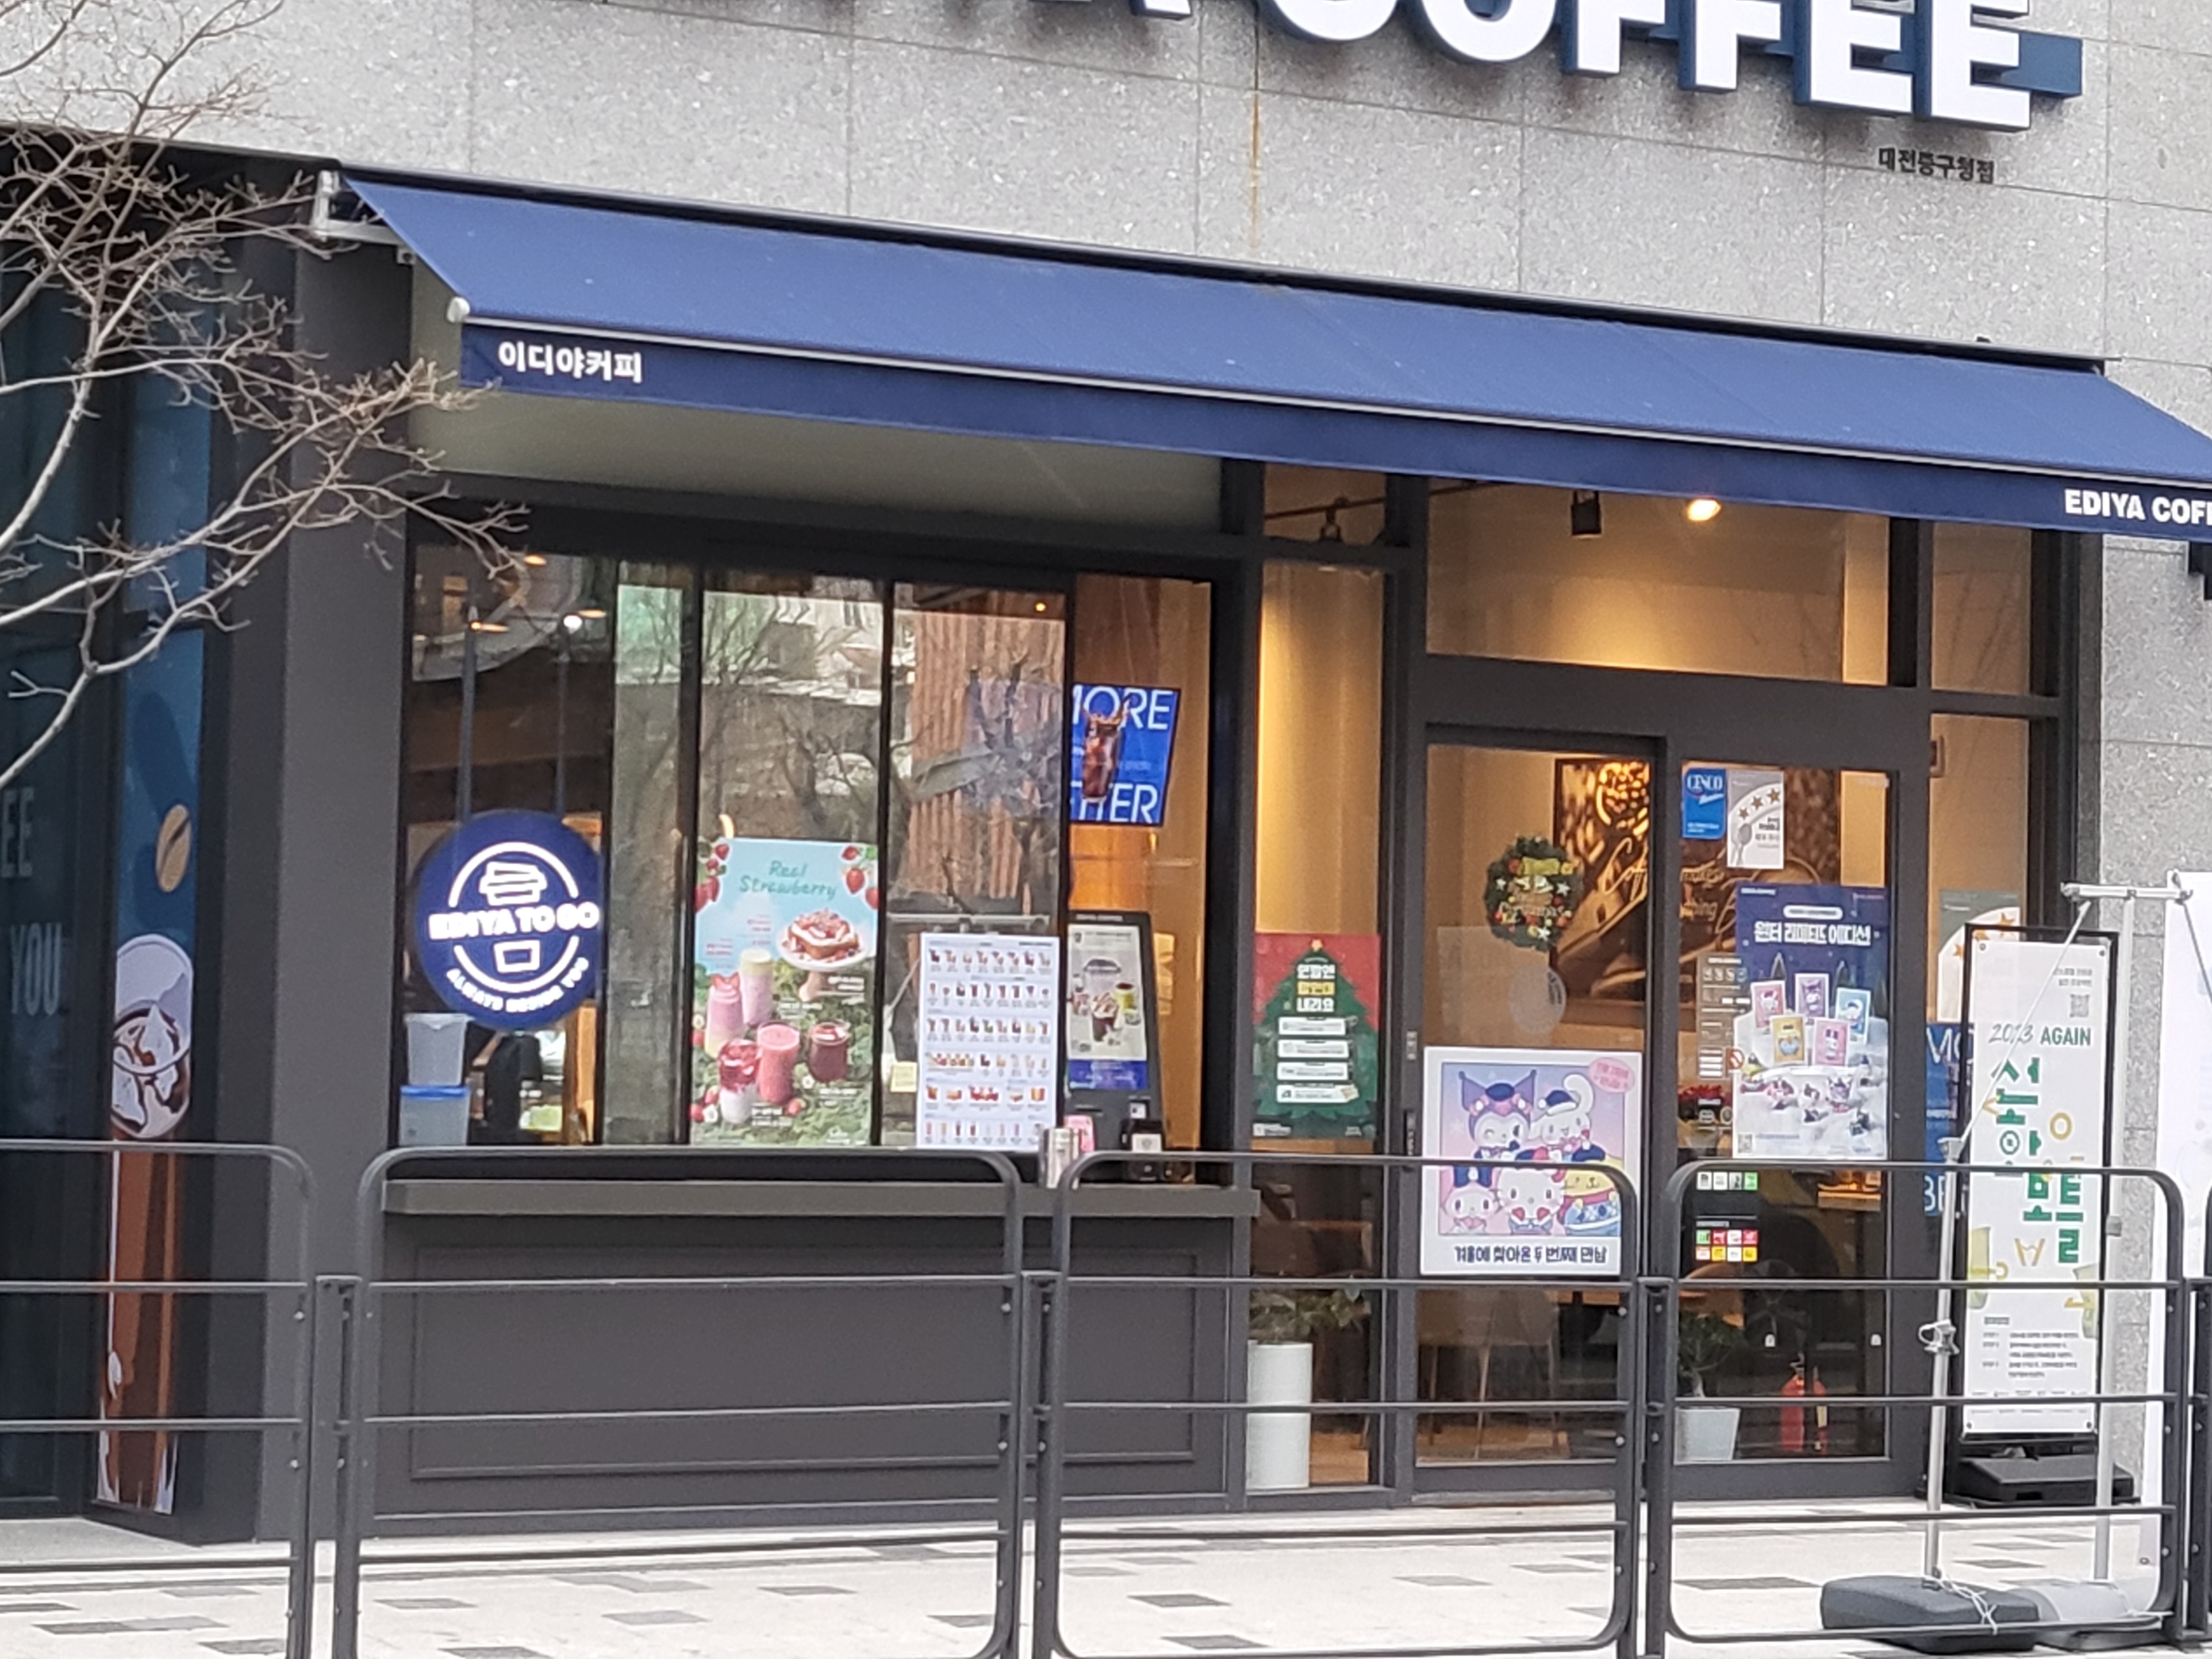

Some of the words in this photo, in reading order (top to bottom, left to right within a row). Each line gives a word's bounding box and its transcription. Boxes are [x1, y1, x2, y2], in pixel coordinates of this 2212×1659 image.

[498, 340, 643, 384] 이디야커피
[2064, 488, 2146, 520] EDIYA
[1073, 685, 1173, 730] ORE
[515, 905, 555, 932] TO
[11, 922, 62, 1016] YOU
[2039, 1026, 2091, 1046] AGAIN
[1454, 1245, 1491, 1264] 겨울에
